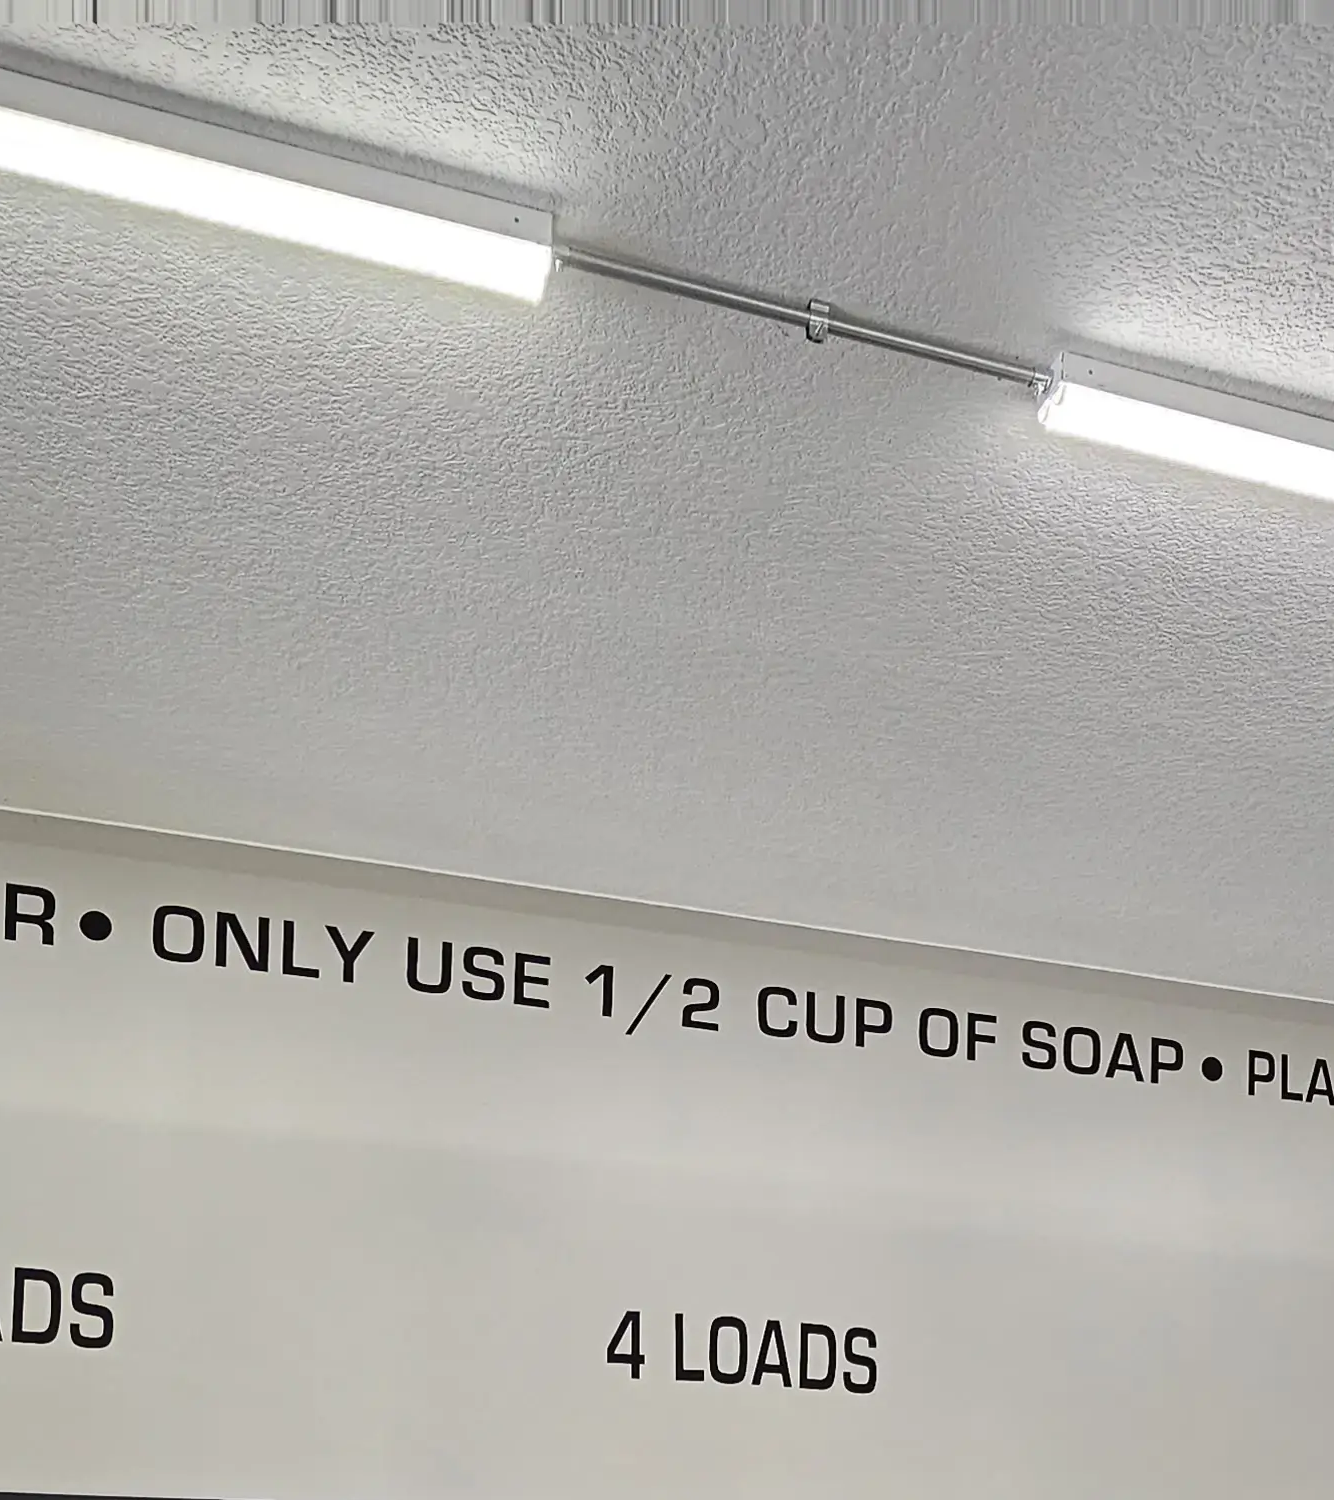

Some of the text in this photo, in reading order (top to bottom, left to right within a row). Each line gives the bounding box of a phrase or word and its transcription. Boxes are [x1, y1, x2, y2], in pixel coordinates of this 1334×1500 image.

[152, 905, 375, 984] ONLY
[406, 936, 551, 1009] USE
[585, 964, 720, 1036] 1/2
[757, 986, 893, 1048] CUP
[918, 1007, 997, 1061] OF
[1022, 1020, 1184, 1084] SOAP
[606, 1310, 877, 1394] 4 LOADS
